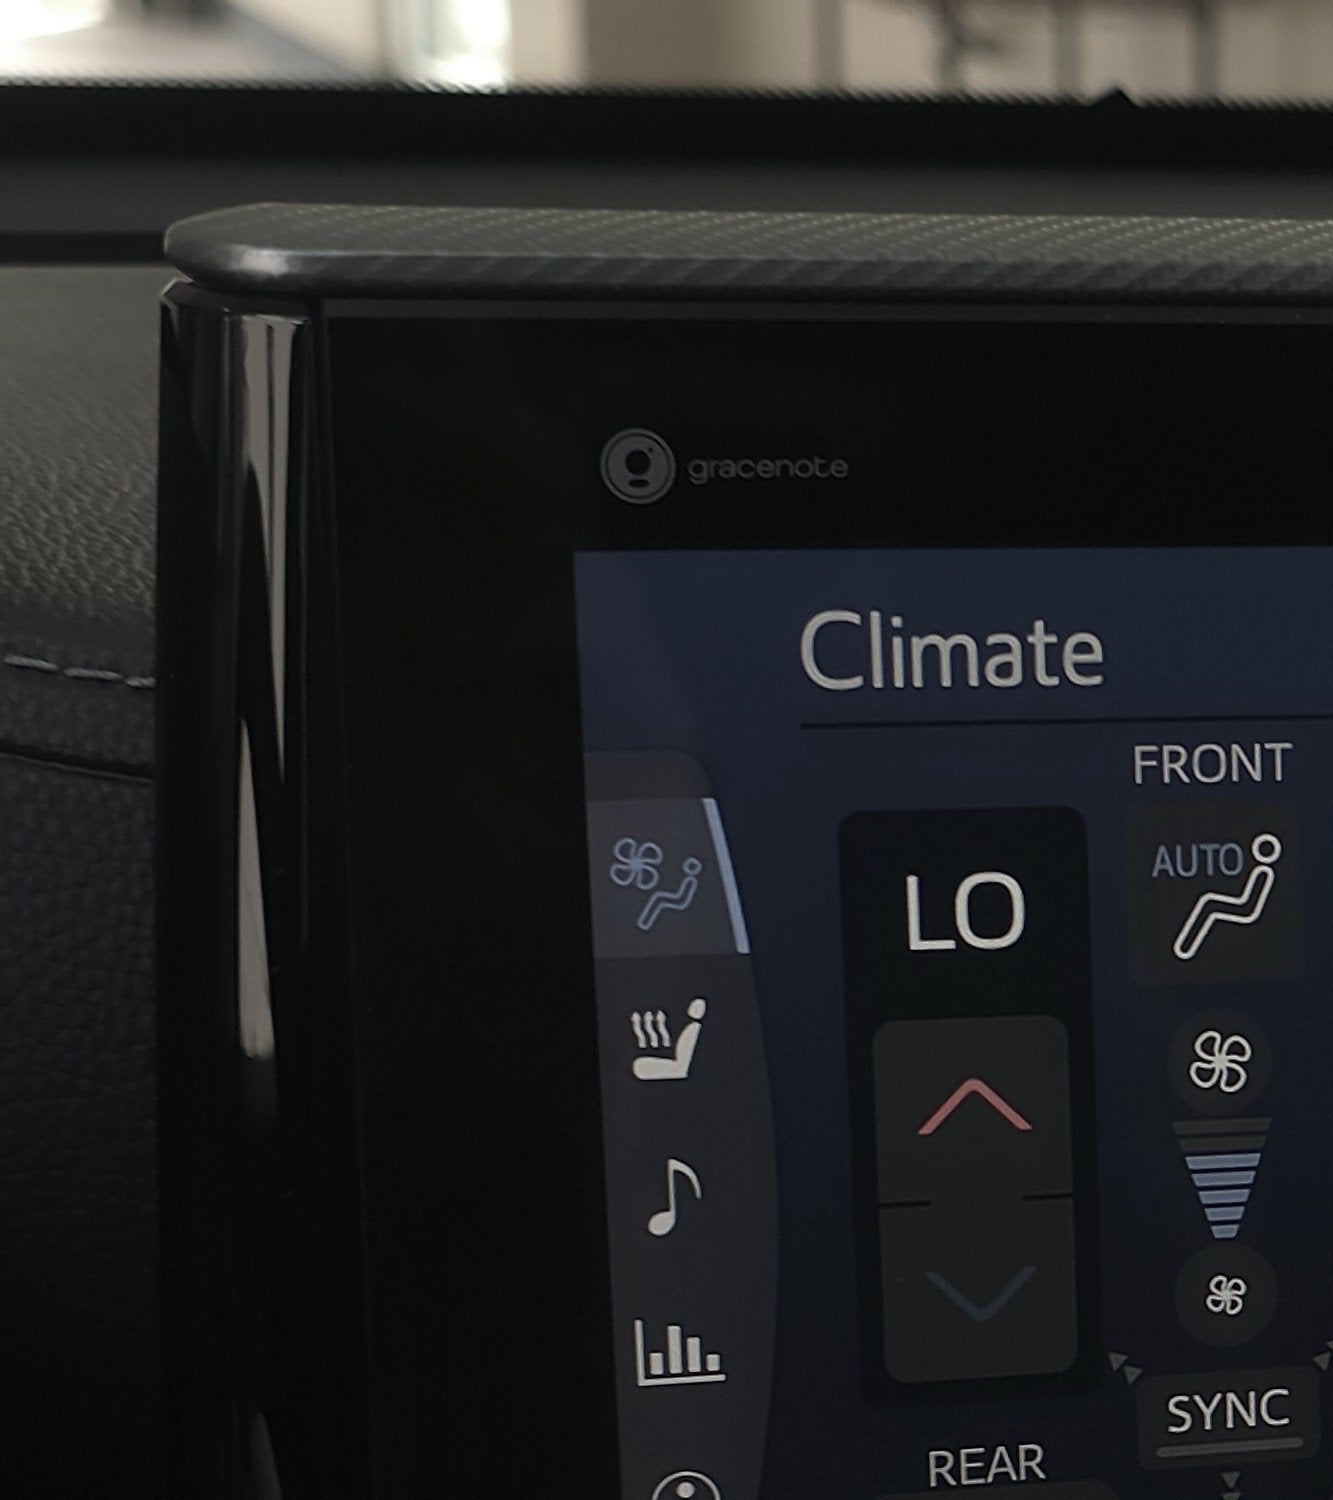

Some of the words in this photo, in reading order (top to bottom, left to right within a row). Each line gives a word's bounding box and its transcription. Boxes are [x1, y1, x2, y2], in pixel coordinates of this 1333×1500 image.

[687, 453, 850, 486] gracenote
[799, 608, 1105, 691] Climate
[1132, 741, 1295, 786] FRONT
[1150, 842, 1246, 879] AUTO
[905, 870, 1027, 952] LO
[1165, 1387, 1291, 1433] SYNC
[927, 1442, 1047, 1488] REAR
